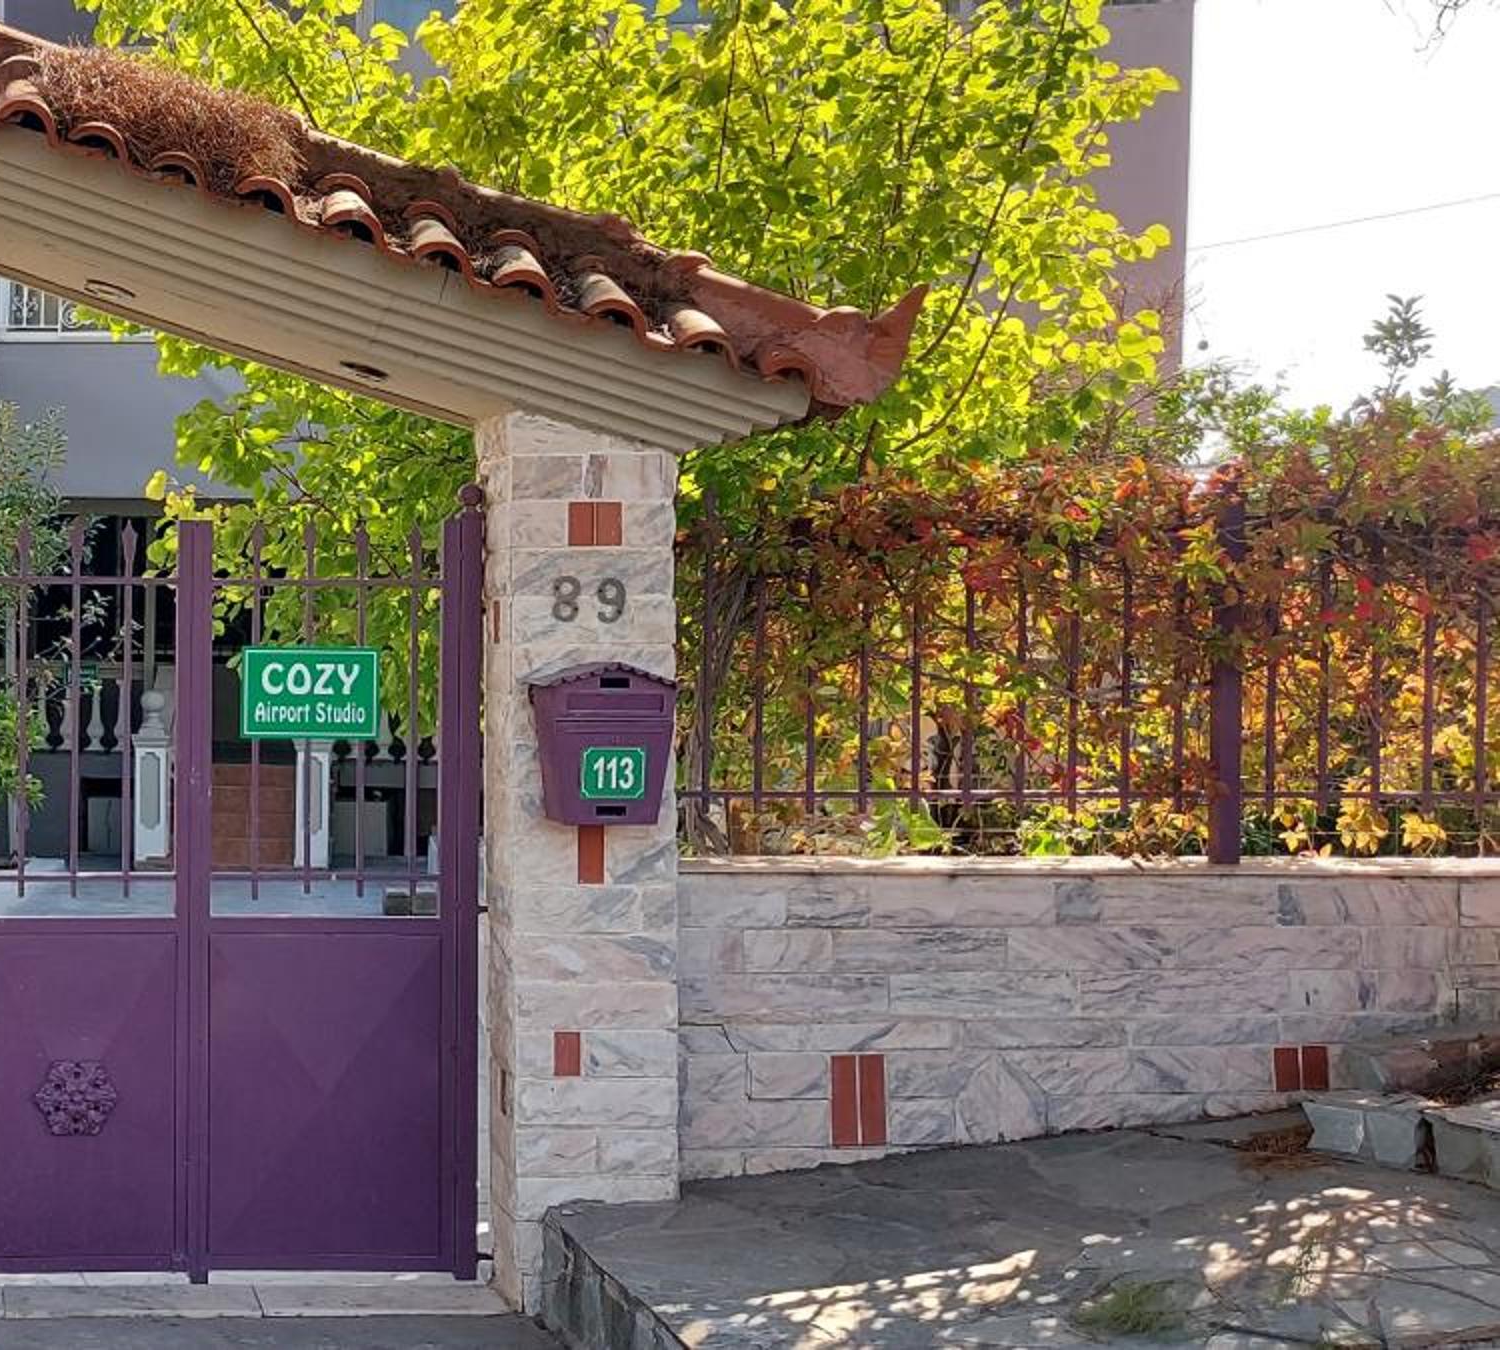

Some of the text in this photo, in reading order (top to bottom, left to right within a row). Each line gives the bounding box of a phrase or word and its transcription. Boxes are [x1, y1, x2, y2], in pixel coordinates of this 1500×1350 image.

[552, 575, 626, 624] 89
[261, 662, 360, 695] COZY
[254, 701, 365, 724] Airport Studio
[592, 756, 635, 790] 113
